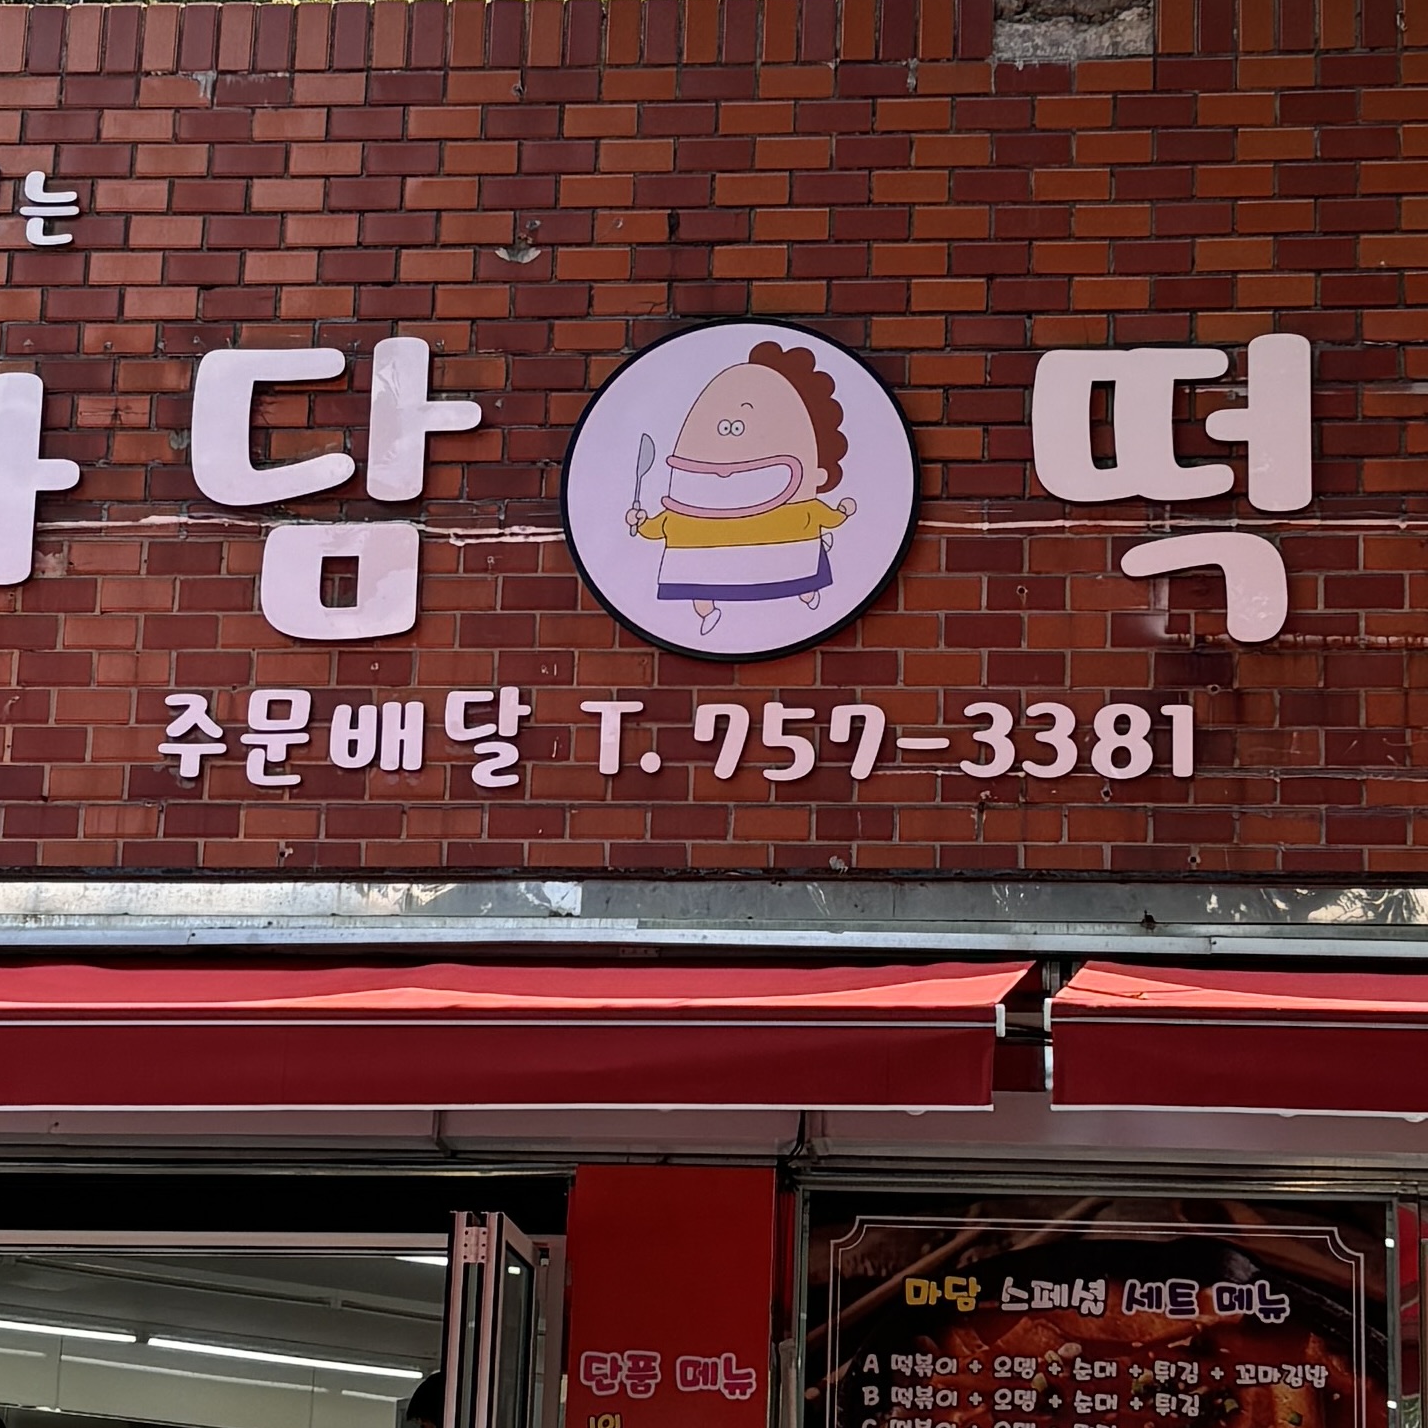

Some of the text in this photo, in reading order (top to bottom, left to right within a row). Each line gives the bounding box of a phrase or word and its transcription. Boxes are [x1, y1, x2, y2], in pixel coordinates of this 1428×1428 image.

[157, 685, 1195, 788] 주문배달 T. 757-3381
[905, 1276, 1290, 1323] 마담 스페셜 세트 메뉴
[580, 1350, 756, 1400] 단품 메뉴
[863, 1354, 879, 1374] A
[891, 1353, 957, 1377] 떡볶이
[993, 1356, 1036, 1379] 오뎅
[1073, 1357, 1117, 1381] 순대
[1154, 1360, 1199, 1384] 튀김
[1235, 1364, 1329, 1388] 꼬마김밥
[862, 1385, 880, 1406] B
[891, 1385, 958, 1410] 떡볶이
[994, 1388, 1037, 1412] 오뎅
[1074, 1390, 1118, 1414] 순대
[1155, 1393, 1200, 1417] 튀김
